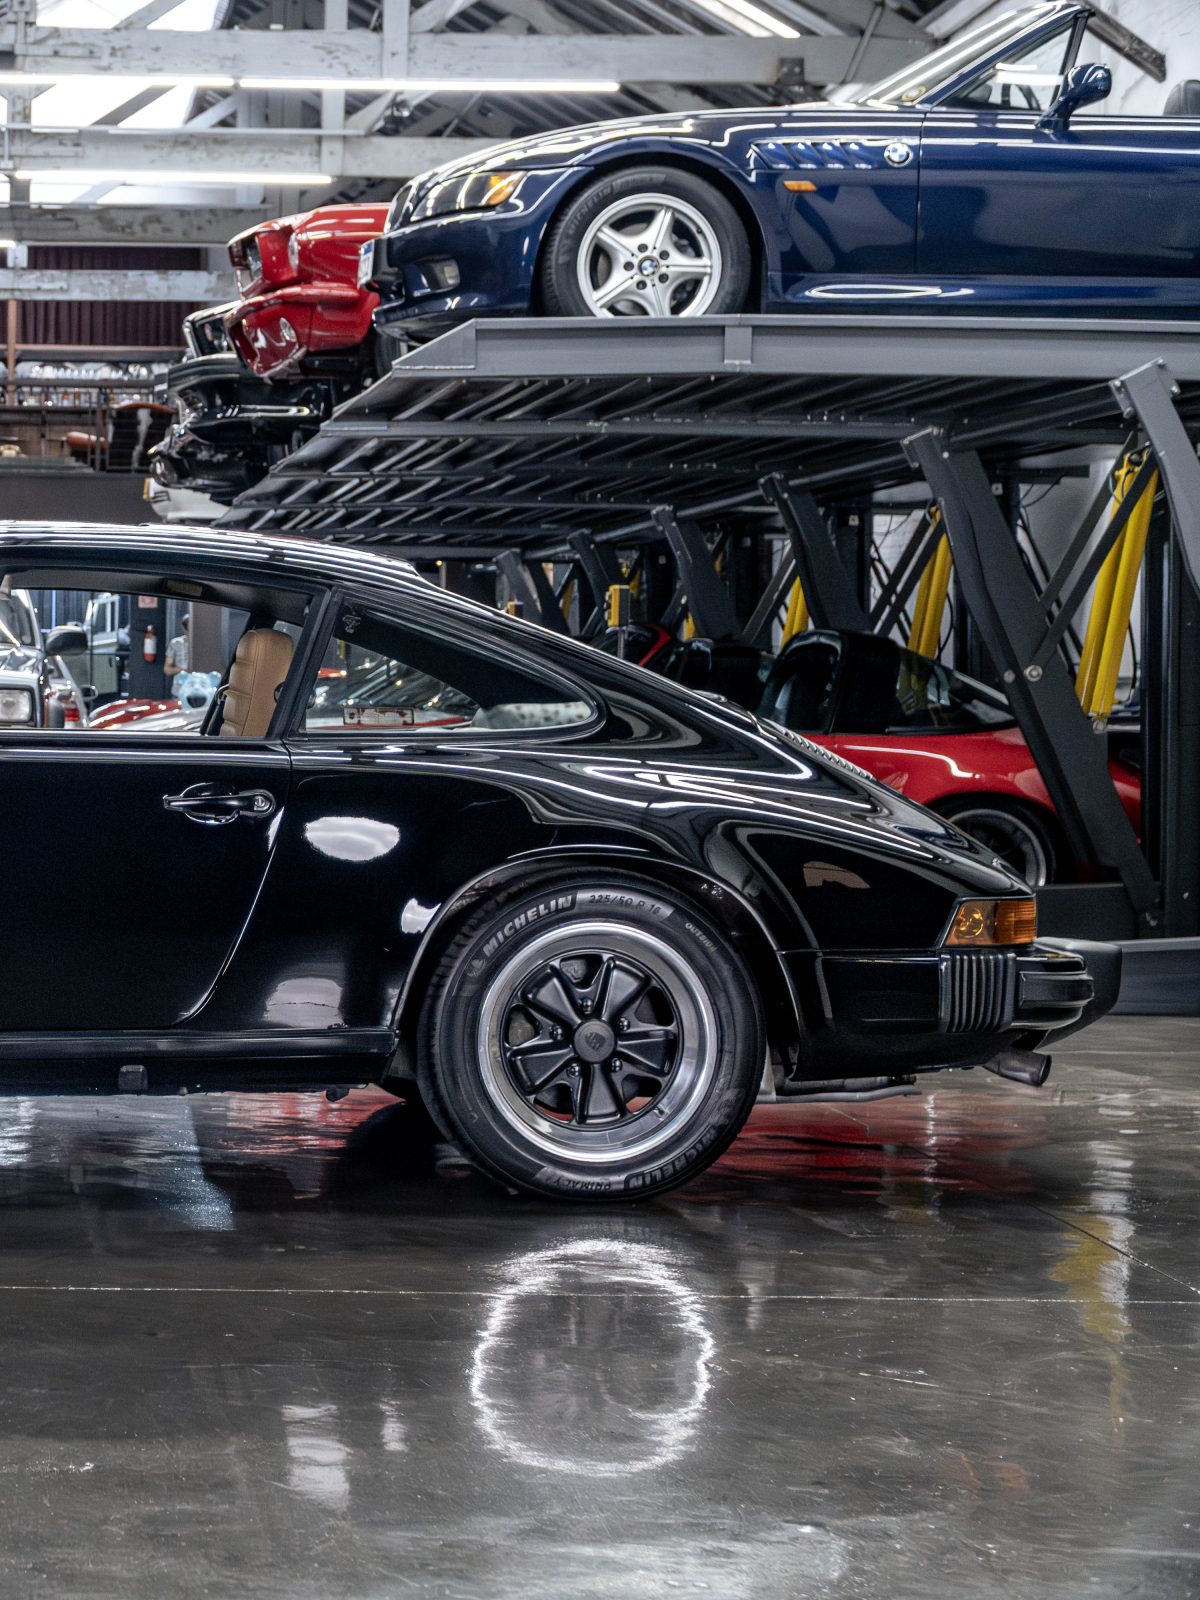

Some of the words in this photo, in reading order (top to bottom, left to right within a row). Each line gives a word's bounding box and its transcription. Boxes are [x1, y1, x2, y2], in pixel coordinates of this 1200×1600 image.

[589, 894, 633, 906] 225/50
[483, 895, 573, 957] MICHELIN
[628, 1124, 721, 1189] MICHELIN
[553, 1177, 612, 1191] PRIMACY
